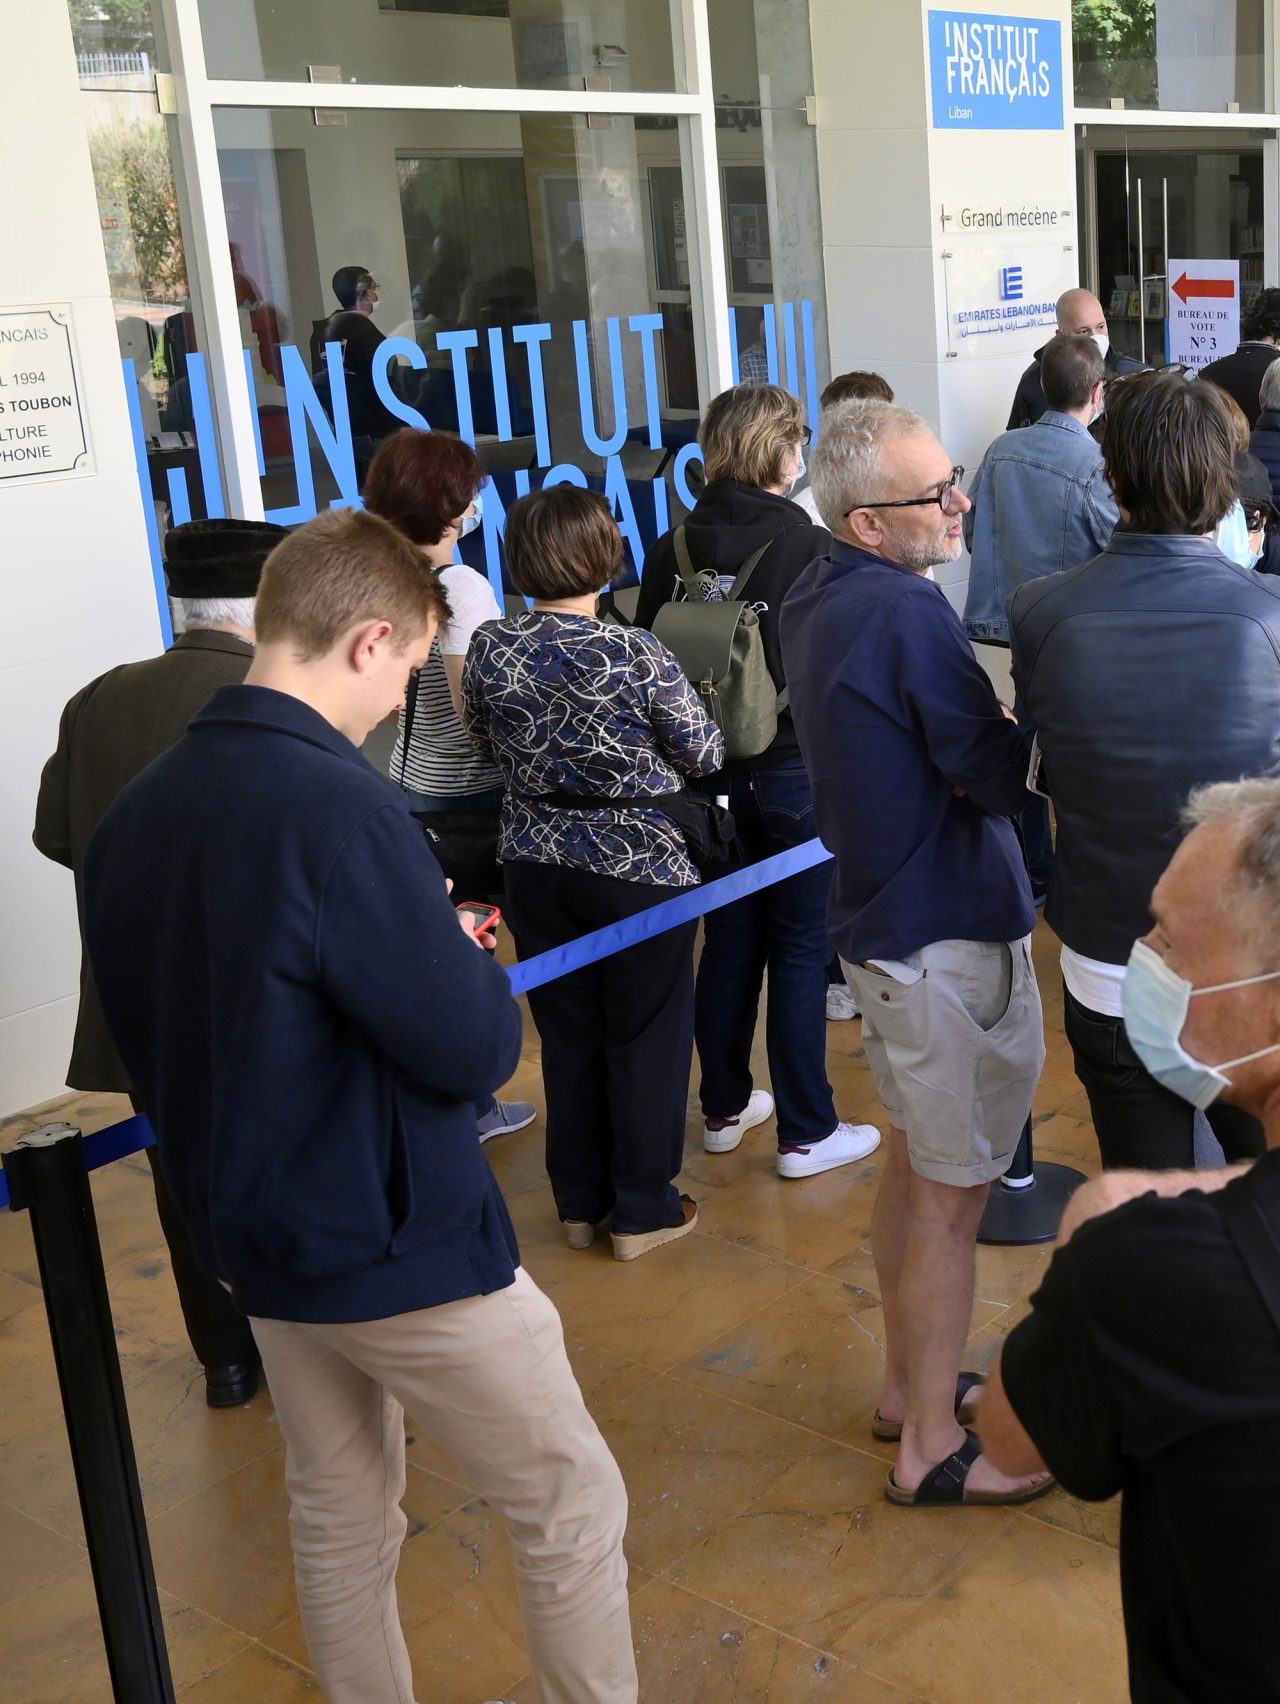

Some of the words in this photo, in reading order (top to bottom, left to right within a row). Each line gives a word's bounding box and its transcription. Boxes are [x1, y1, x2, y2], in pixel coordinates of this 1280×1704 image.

[944, 21, 1039, 64] INSTITUT
[946, 56, 1050, 103] FRANÇAIS
[949, 106, 973, 119] Liban
[961, 207, 1003, 228] Grand
[1007, 206, 1058, 226] mécène
[958, 308, 1001, 323] EMIRATES
[1002, 304, 1041, 318] LEBANON
[1042, 301, 1058, 314] BAN
[1177, 310, 1214, 319] BUREAU
[1216, 311, 1229, 320] DE
[0, 327, 48, 343] NCAIS
[1190, 322, 1216, 332] VOTE
[1190, 336, 1206, 349] N°
[1209, 337, 1217, 350] 3
[1178, 354, 1214, 364] BUREAU
[13, 371, 45, 385] 1994
[9, 395, 72, 412] TOUBON
[0, 445, 52, 462] HONIE
